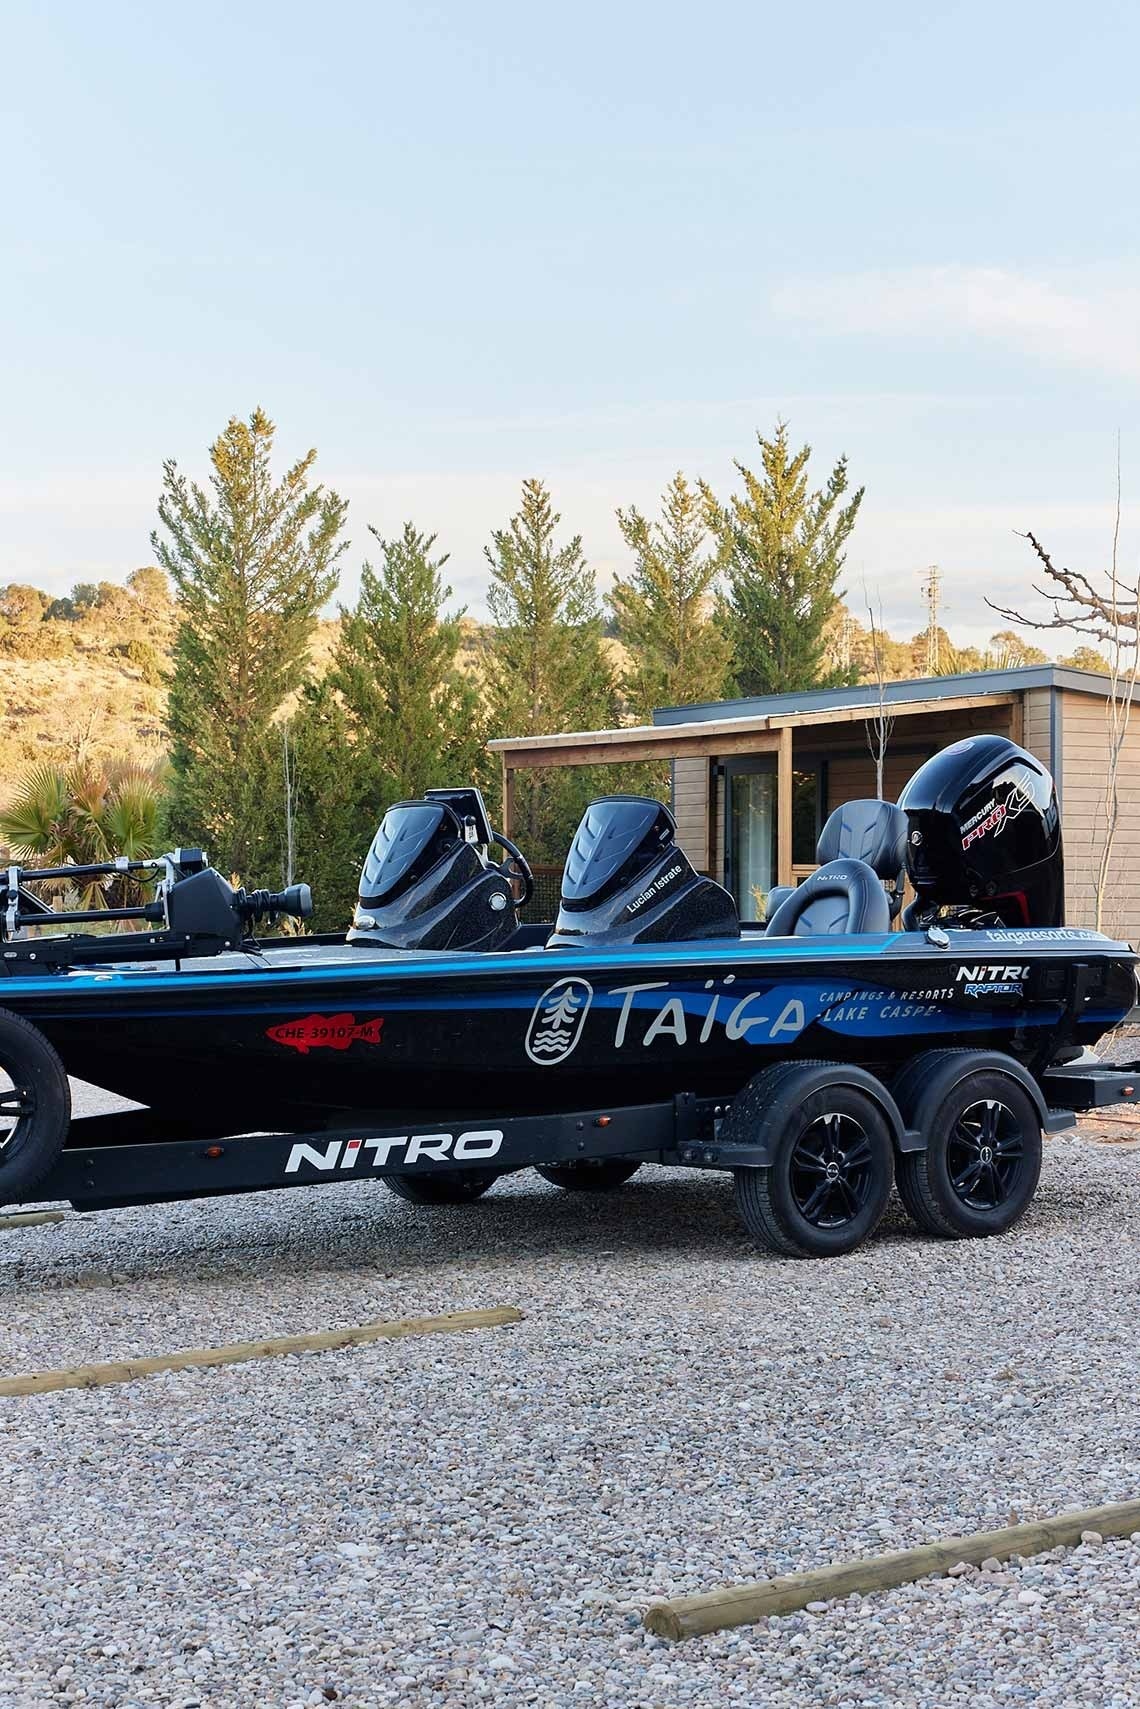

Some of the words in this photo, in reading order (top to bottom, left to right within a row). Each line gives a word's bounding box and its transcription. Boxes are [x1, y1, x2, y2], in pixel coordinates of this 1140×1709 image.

[960, 798, 996, 834] MERCURY
[962, 804, 1007, 851] PRO
[626, 887, 657, 913] Lucian
[653, 865, 682, 890] Istrate
[819, 990, 885, 1002] CAMPINGS
[887, 991, 896, 1000] &
[899, 988, 955, 1000] RESORTS
[964, 983, 1024, 999] RAPTOR
